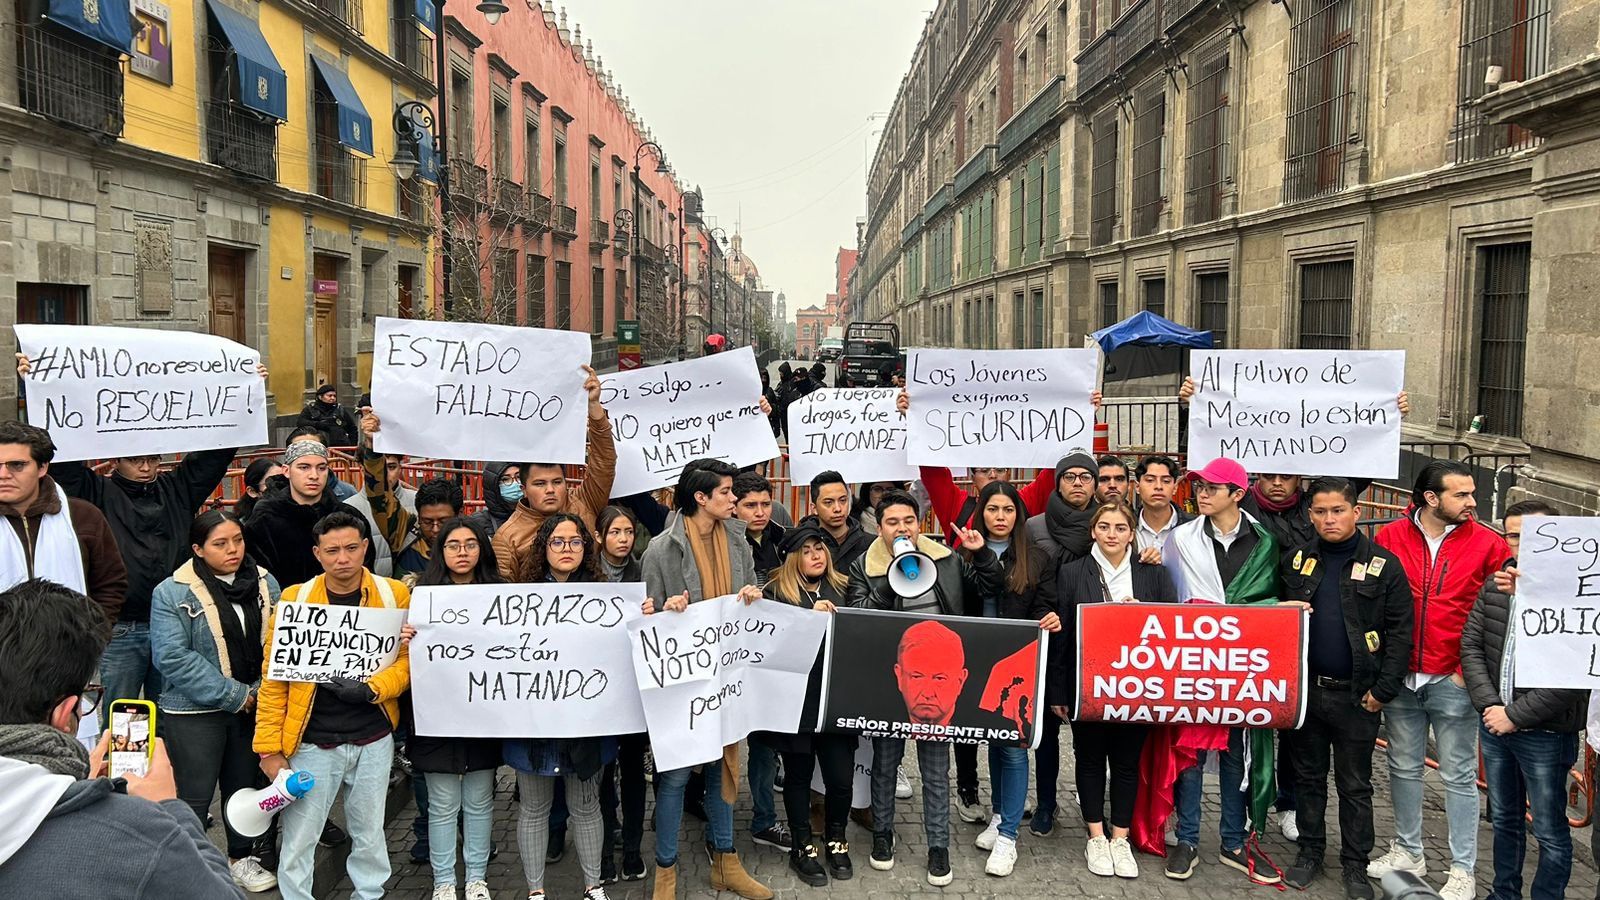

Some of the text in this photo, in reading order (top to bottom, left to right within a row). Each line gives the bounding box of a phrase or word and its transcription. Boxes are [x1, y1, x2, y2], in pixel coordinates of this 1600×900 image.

[28, 346, 255, 382] #AMLOnoresuelve
[387, 333, 521, 375] ESTADO
[912, 353, 1048, 387] Los Jóvenes
[1199, 356, 1221, 393] Al
[1320, 357, 1357, 385] de
[45, 394, 83, 431] No
[435, 383, 564, 422] FALLIDO
[801, 403, 857, 430] drogas,
[860, 402, 890, 423] fue
[951, 392, 1030, 411] exigimos
[1207, 399, 1388, 429] México lo están
[649, 415, 703, 444] quiero
[706, 409, 734, 433] que
[738, 404, 760, 418] me
[925, 406, 1085, 452] SEGURIDAD
[642, 433, 712, 472] MATEN
[1219, 434, 1348, 460] MATANDO
[282, 603, 367, 632] ALTO AL
[428, 591, 625, 628] Los ABRAZOS
[277, 625, 396, 655] JUVENICIDIO
[639, 625, 678, 662] No
[744, 617, 776, 637] un
[1139, 614, 1242, 641] A LOS
[274, 647, 383, 673] EN EL PAÍS
[426, 632, 560, 662] nos están
[1110, 639, 1271, 673] JÓVENES
[468, 668, 609, 703] MATANDO
[647, 648, 719, 689] VOTO,
[1093, 673, 1287, 703] NOS ESTÁN
[836, 716, 1020, 741] SEÑOR PRESIDENTE NOS
[1102, 704, 1273, 726] MATANDO
[861, 729, 912, 740] ESTÁN
[913, 734, 990, 745] MATANDO
